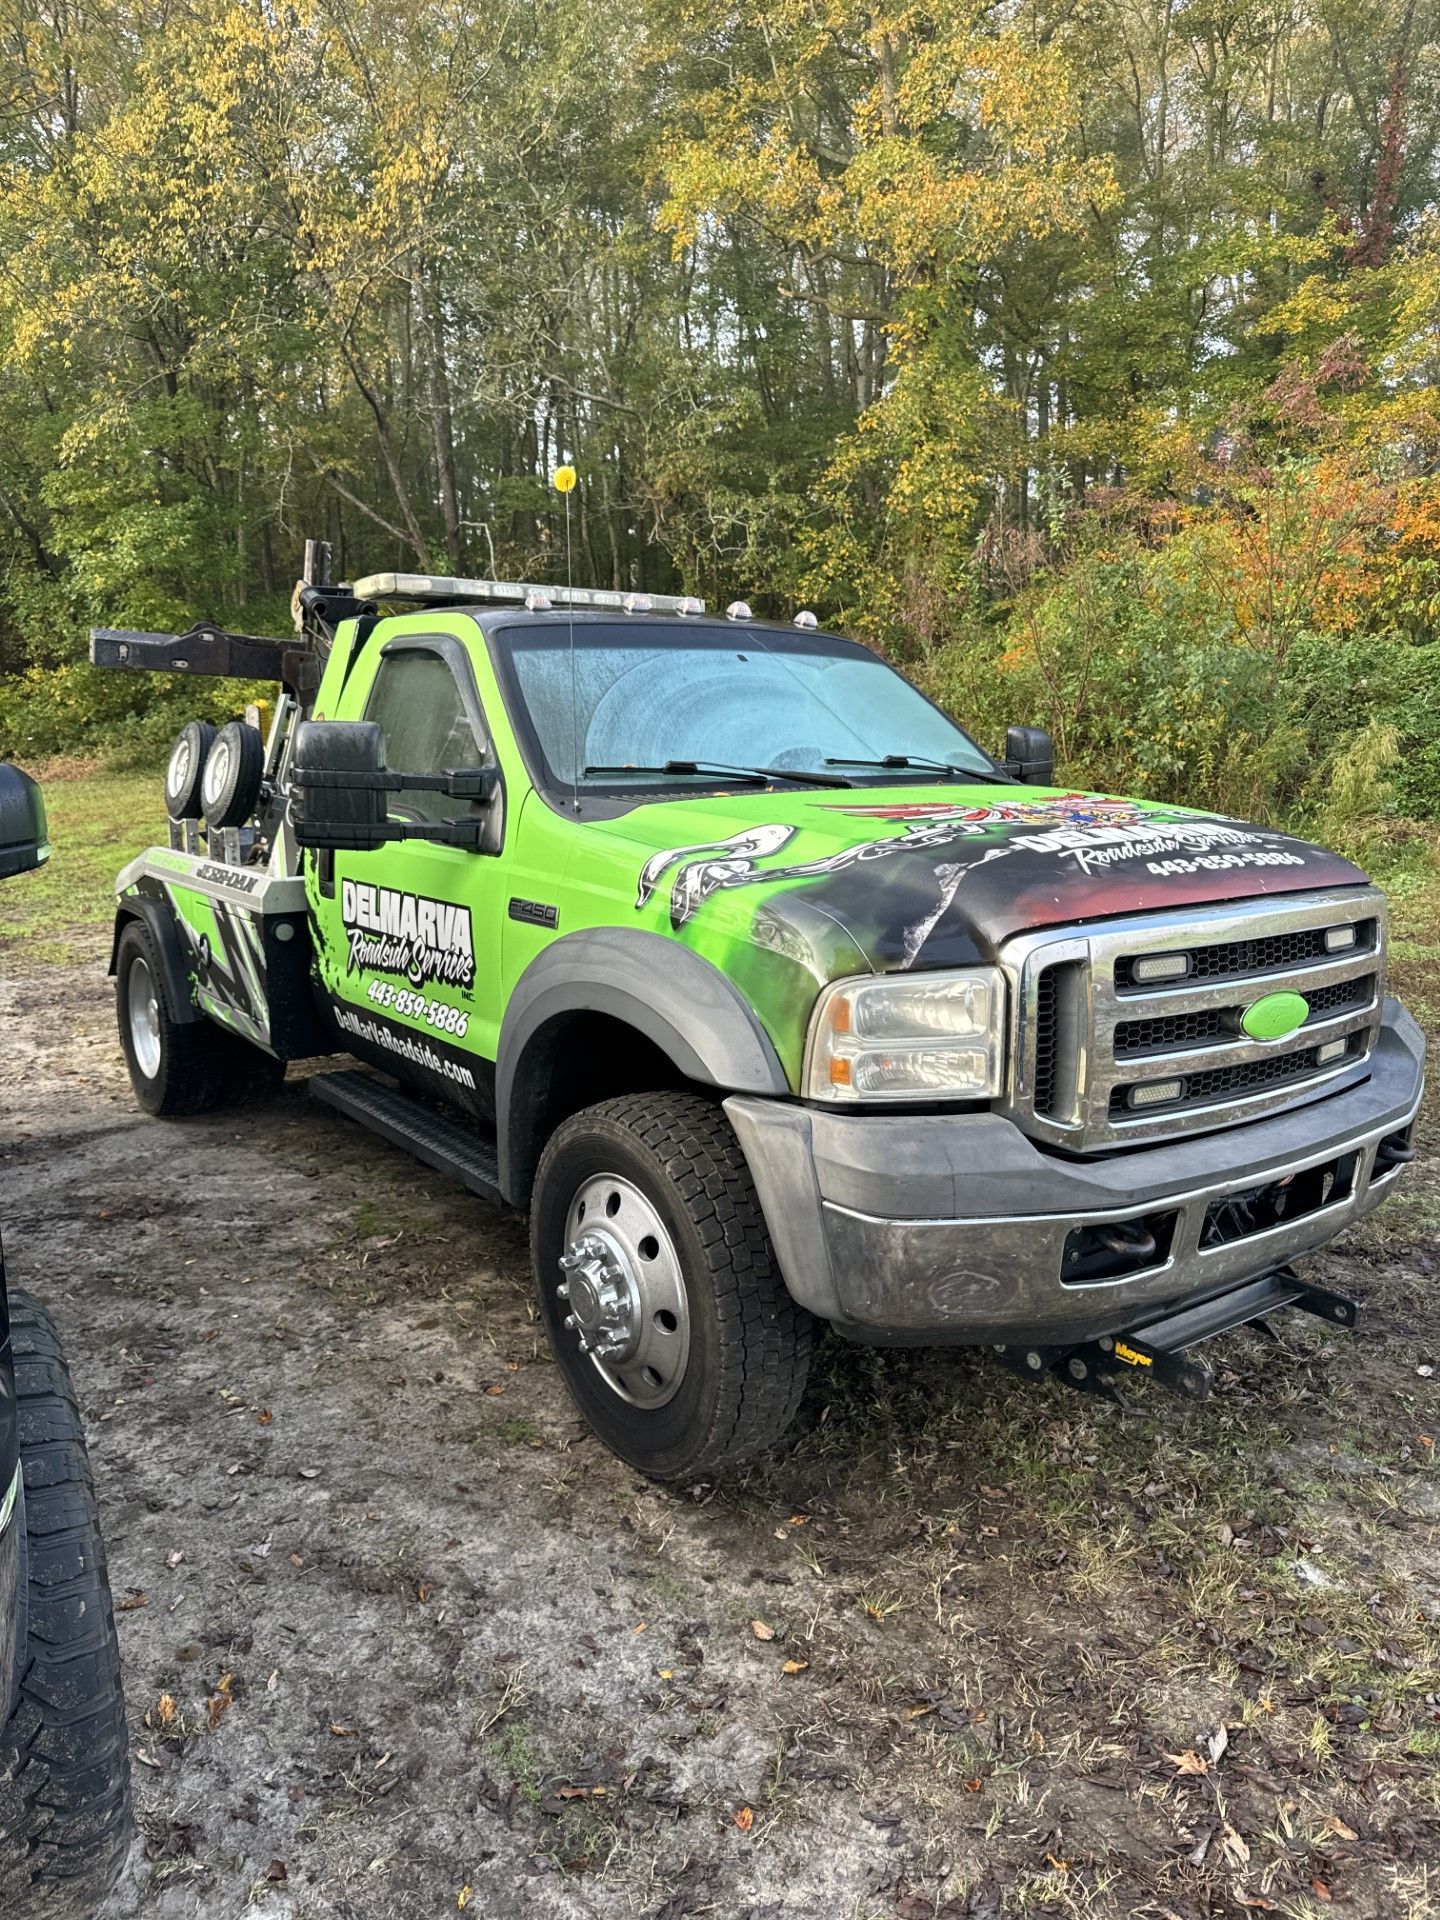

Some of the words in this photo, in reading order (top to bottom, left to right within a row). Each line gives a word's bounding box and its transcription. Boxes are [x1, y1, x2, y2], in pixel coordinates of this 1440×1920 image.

[1009, 823, 1248, 853] DELMARVA
[1058, 837, 1180, 876] Roadside
[1174, 831, 1263, 851] Services
[342, 880, 472, 955] DELMARVA
[347, 928, 410, 976] Roadside
[408, 935, 474, 983] Services
[333, 1006, 476, 1090] DelMarVaRoadside.com
[1115, 1342, 1153, 1367] Meyer
